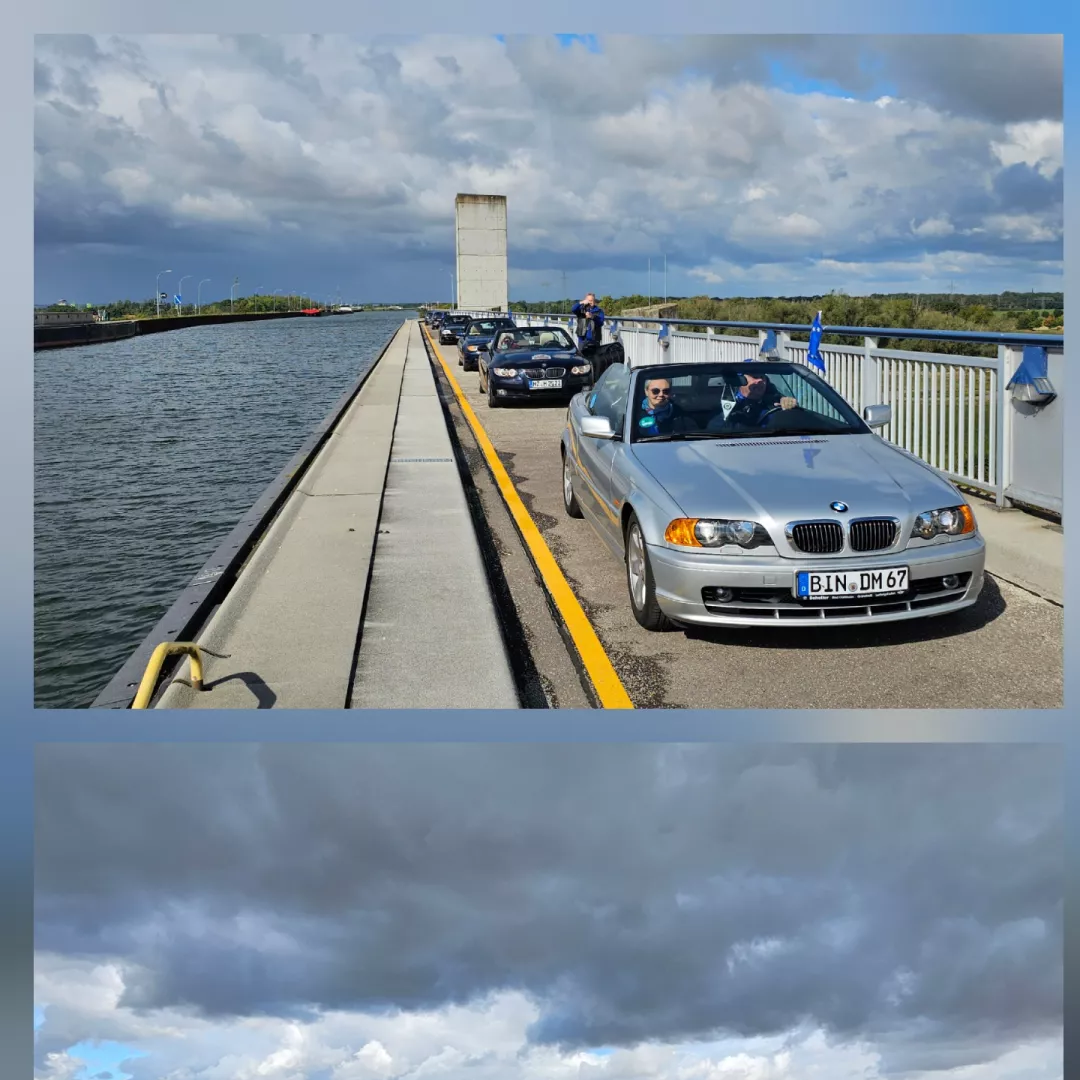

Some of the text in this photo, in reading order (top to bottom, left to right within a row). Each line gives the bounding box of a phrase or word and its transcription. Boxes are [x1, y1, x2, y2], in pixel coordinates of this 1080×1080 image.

[810, 569, 907, 593] BIN DM 67
